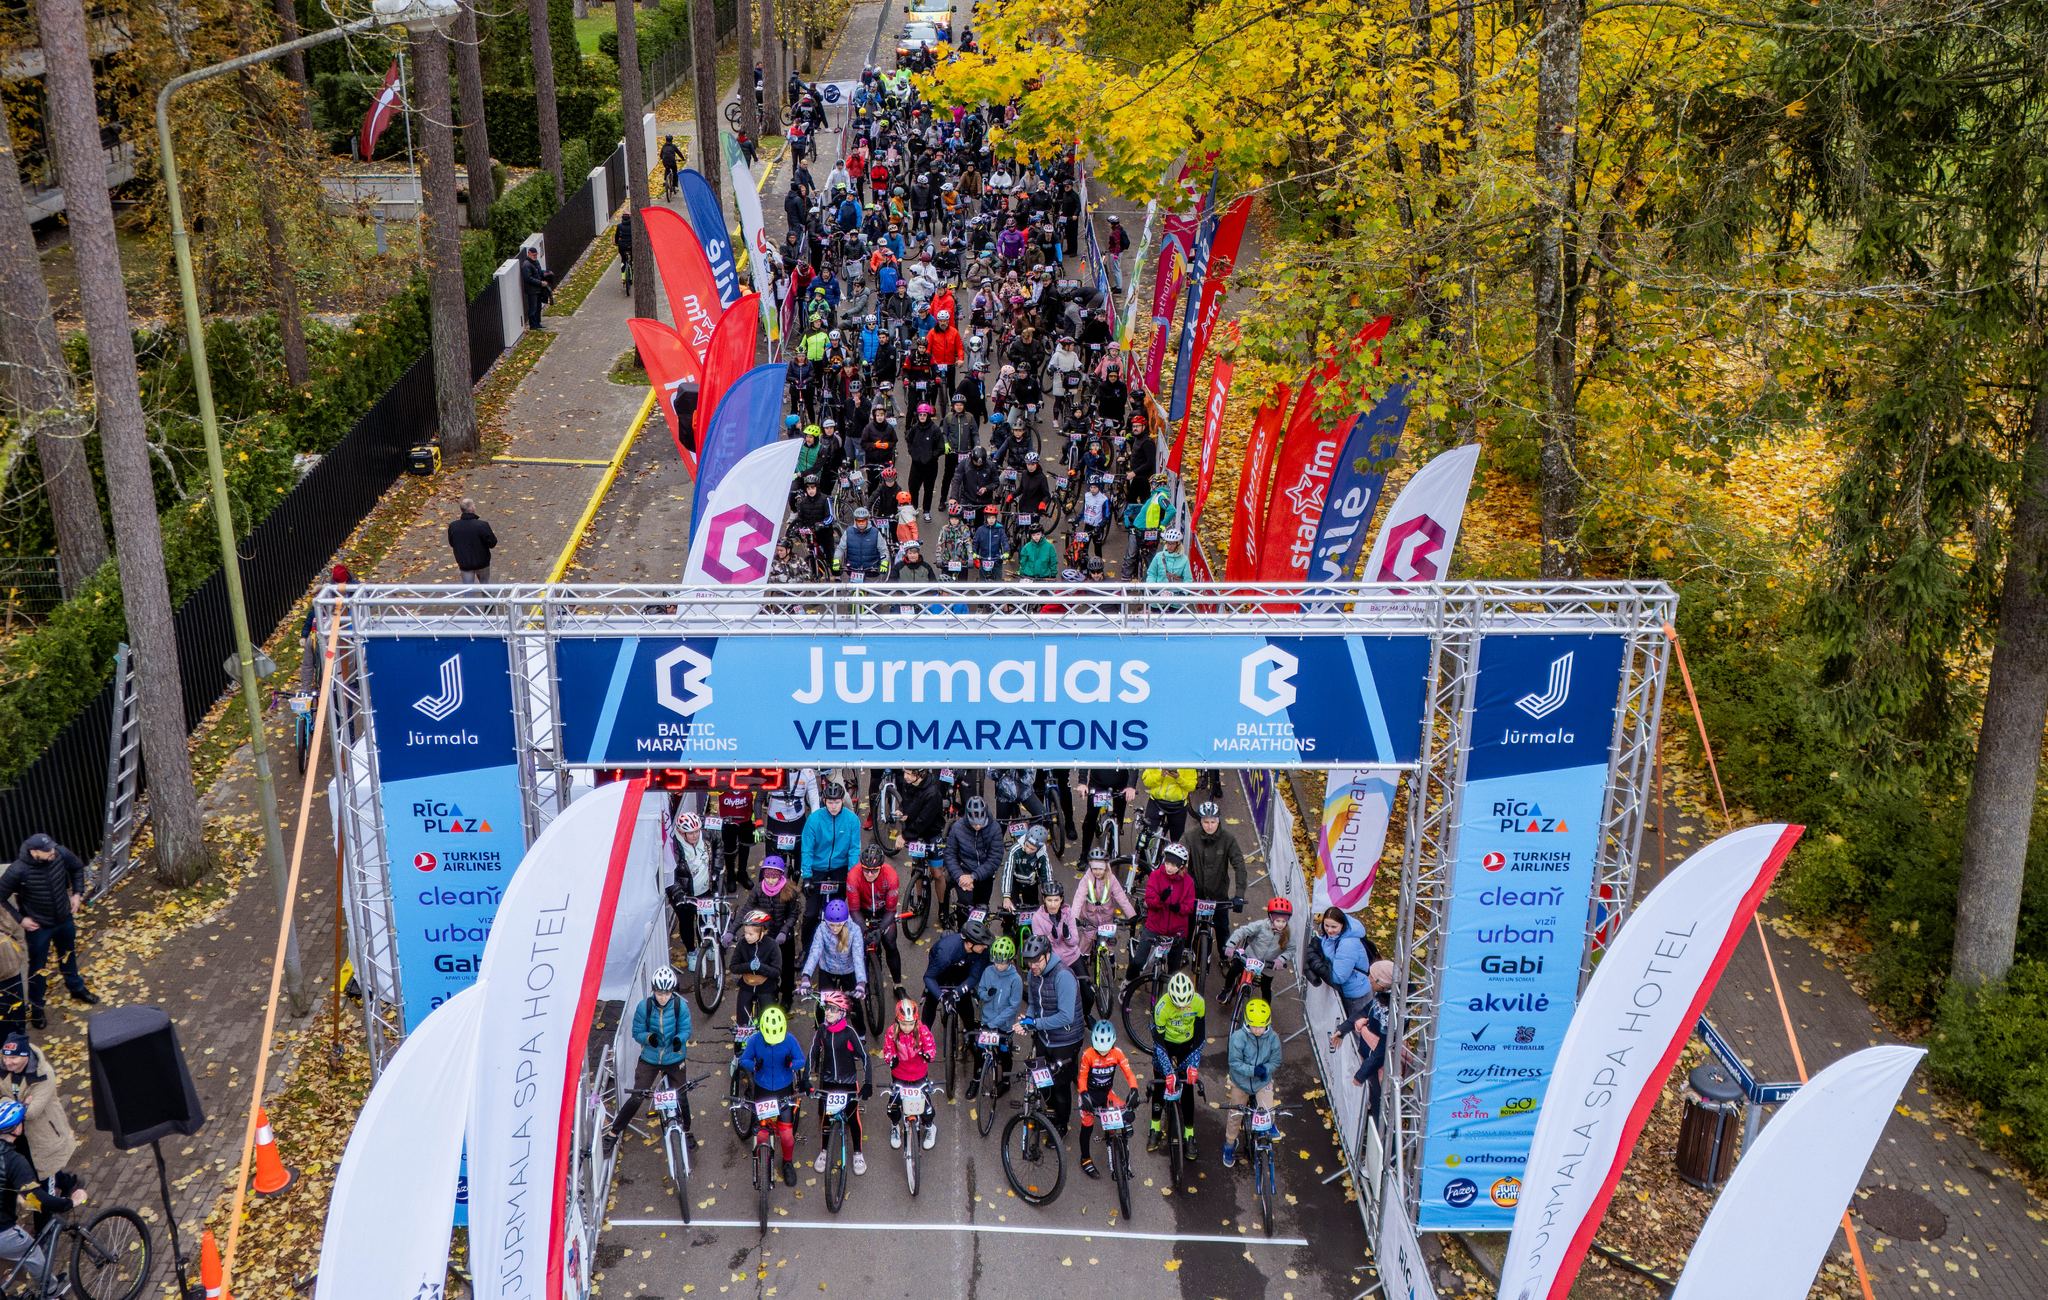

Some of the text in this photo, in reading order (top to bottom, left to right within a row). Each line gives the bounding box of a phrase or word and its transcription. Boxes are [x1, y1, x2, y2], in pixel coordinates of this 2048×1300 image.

[1291, 441, 1336, 570] star fm
[791, 645, 1151, 704] Jūrmalas
[658, 723, 715, 736] BALTIC
[793, 719, 1149, 750] VELOMARATONS
[1236, 722, 1294, 736] BALTIC
[406, 731, 479, 746] Jūrmala
[637, 738, 738, 751] MARATHONS
[1213, 738, 1316, 751] MARATHONS
[1500, 729, 1574, 745] Jūrmala
[413, 800, 464, 817] RĪGA
[1492, 799, 1543, 817] RĪGA
[424, 819, 493, 833] PLAZA
[1500, 819, 1569, 833] PLAZA
[443, 852, 500, 861] TURKISH
[1513, 852, 1571, 861] TURKISH
[443, 861, 502, 872] AIRLINES
[1511, 862, 1570, 872] AIRLINES
[1477, 924, 1554, 943] urban
[520, 893, 570, 1021] HOTEL
[1480, 955, 1543, 974] Gabi
[1468, 993, 1549, 1012] akvilė
[1585, 1046, 1634, 1109] SPA
[1618, 921, 1698, 1032] HOTEL
[1461, 1043, 1496, 1051] Rexona
[514, 1031, 545, 1108] SPA
[1456, 1063, 1543, 1084] myfitness
[828, 1094, 846, 1105] 333
[1102, 1113, 1120, 1123] 013
[1446, 1182, 1477, 1201] Fazer
